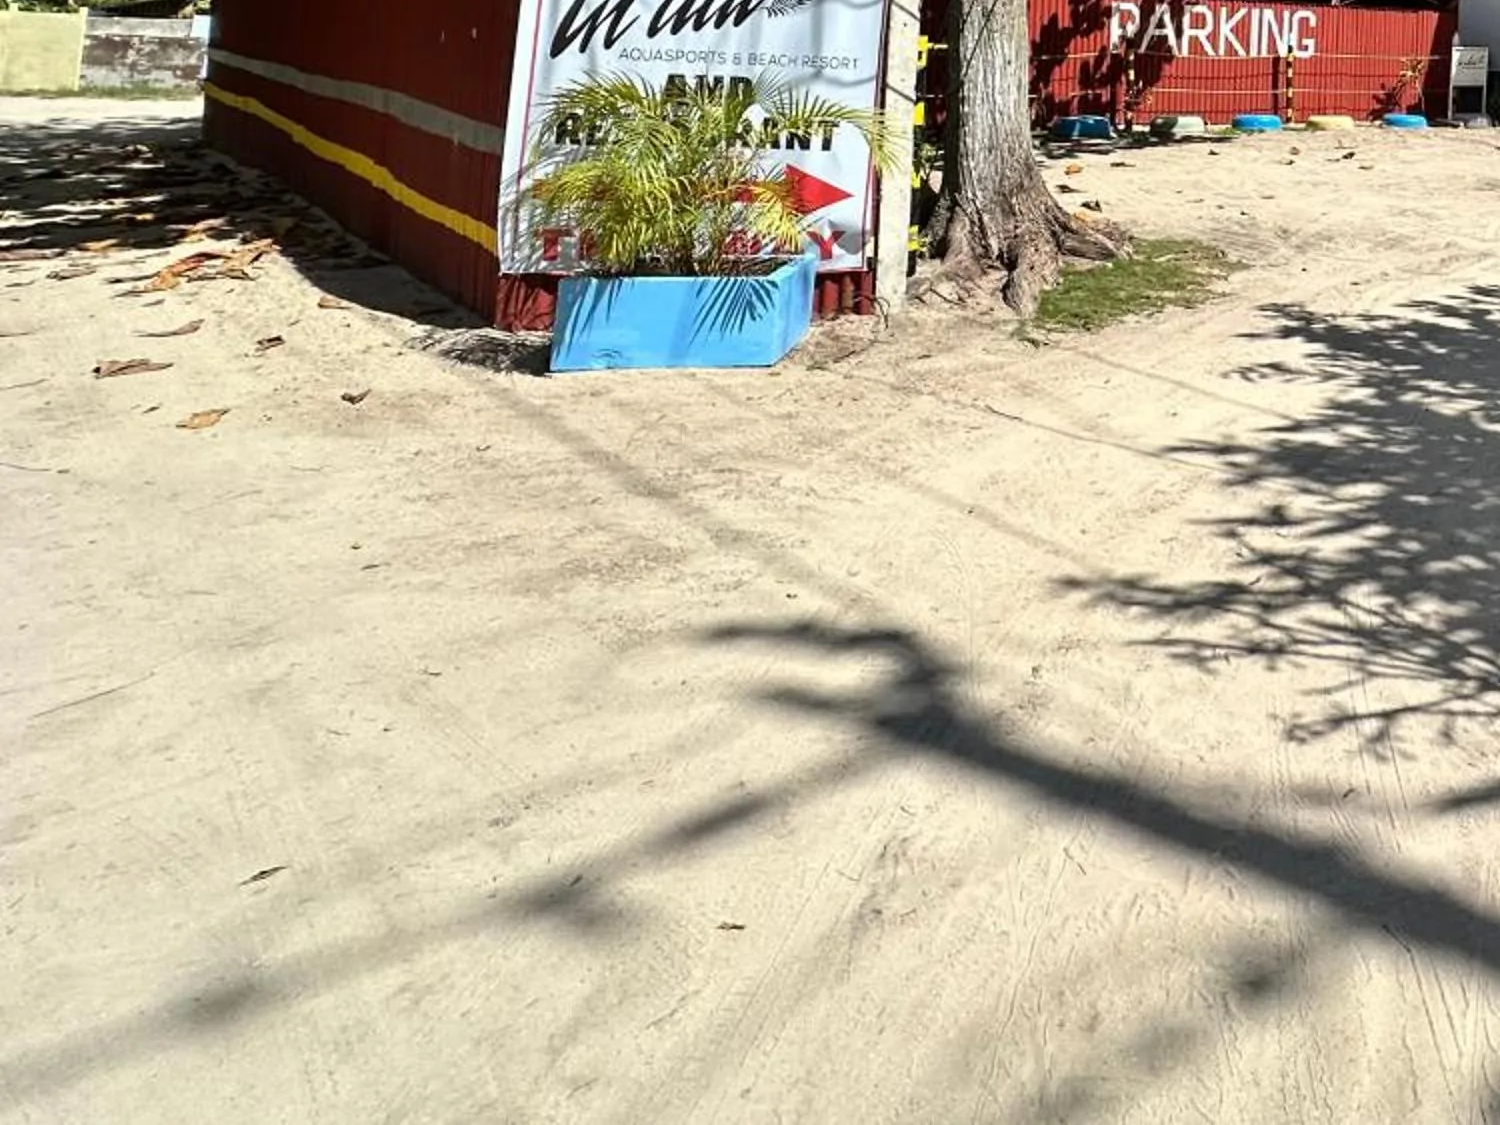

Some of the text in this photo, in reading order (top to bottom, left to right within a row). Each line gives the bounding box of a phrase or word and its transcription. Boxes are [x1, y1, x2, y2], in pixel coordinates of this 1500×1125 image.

[1109, 1, 1317, 58] PARKING
[618, 46, 727, 66] AQUASPORTS
[748, 52, 797, 68] BEACH
[801, 54, 860, 70] RESORT
